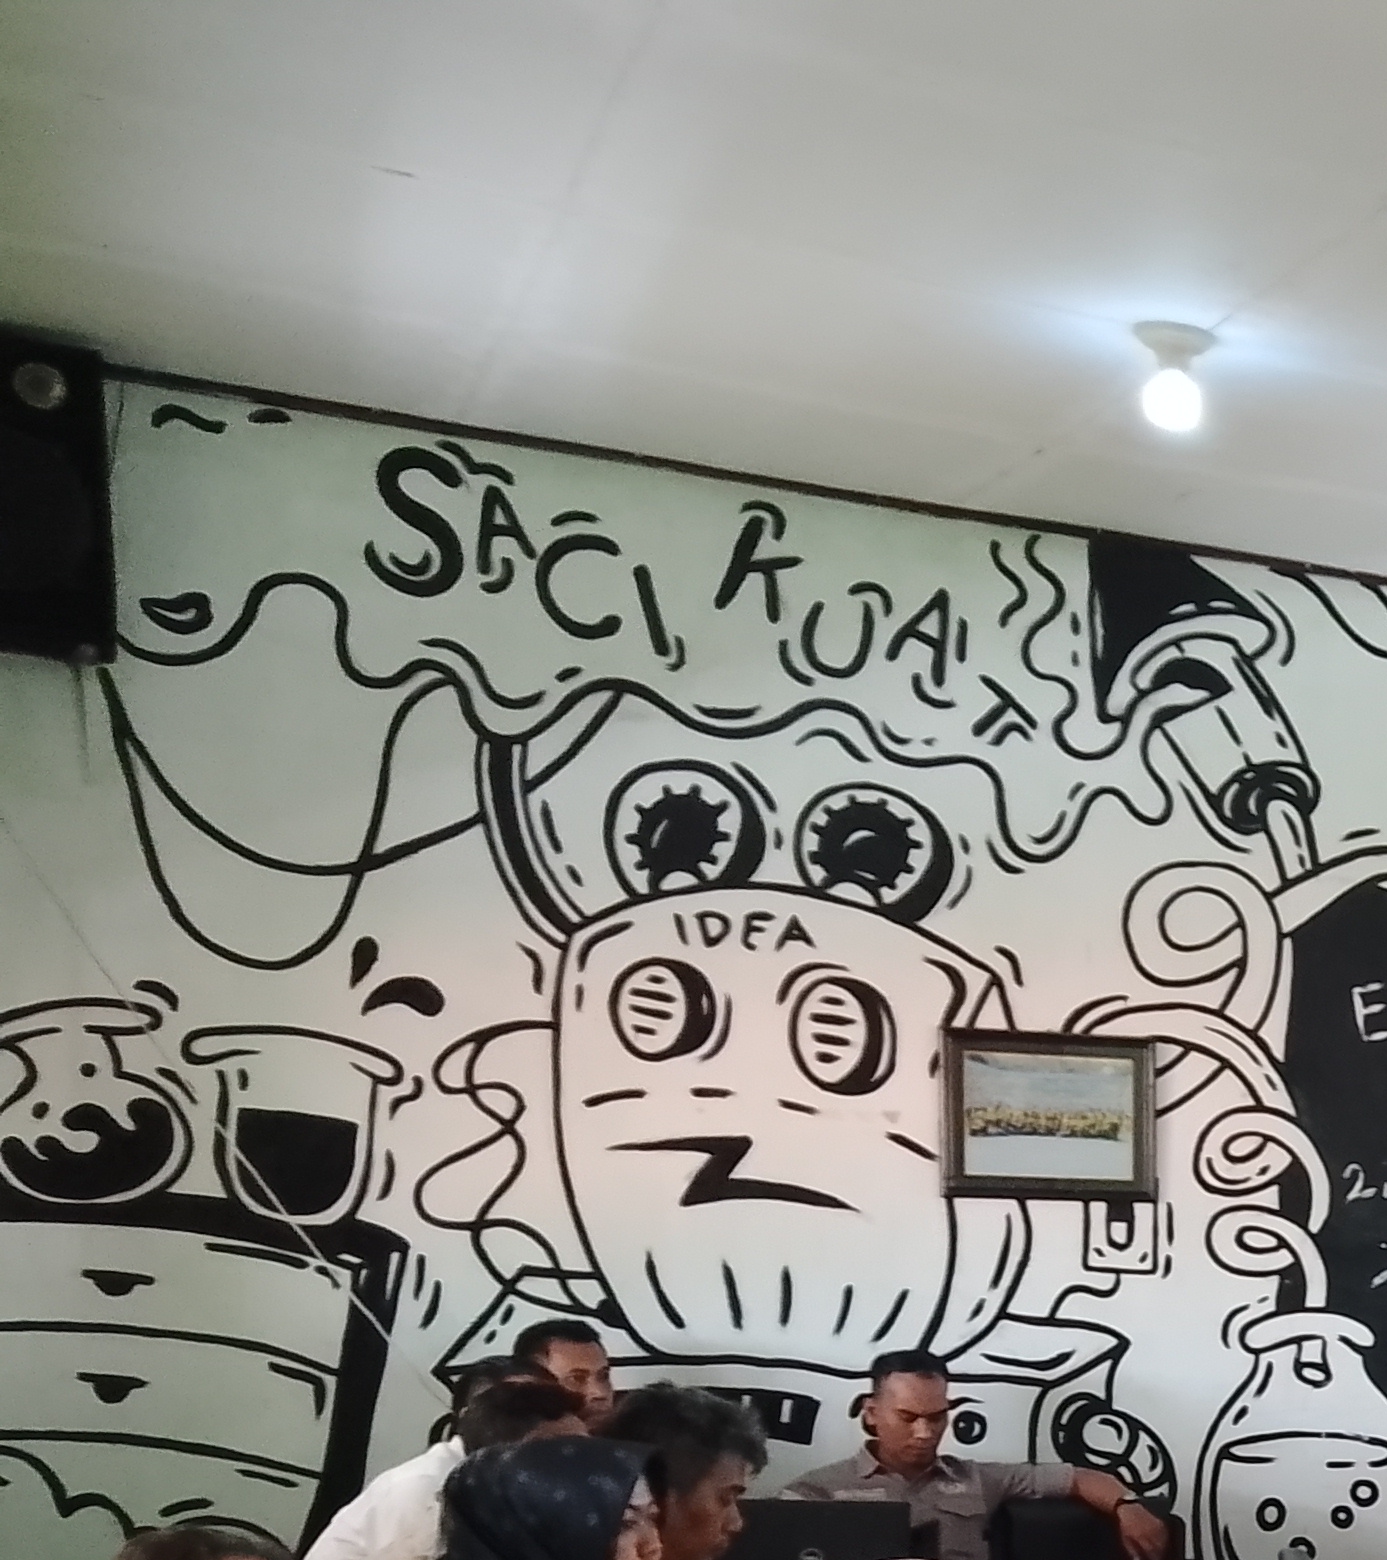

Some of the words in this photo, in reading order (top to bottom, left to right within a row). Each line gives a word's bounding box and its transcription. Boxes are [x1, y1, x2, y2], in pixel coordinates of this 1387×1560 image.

[365, 446, 668, 655] SACI
[715, 516, 1036, 735] KUAT
[673, 910, 816, 952] IDEA
